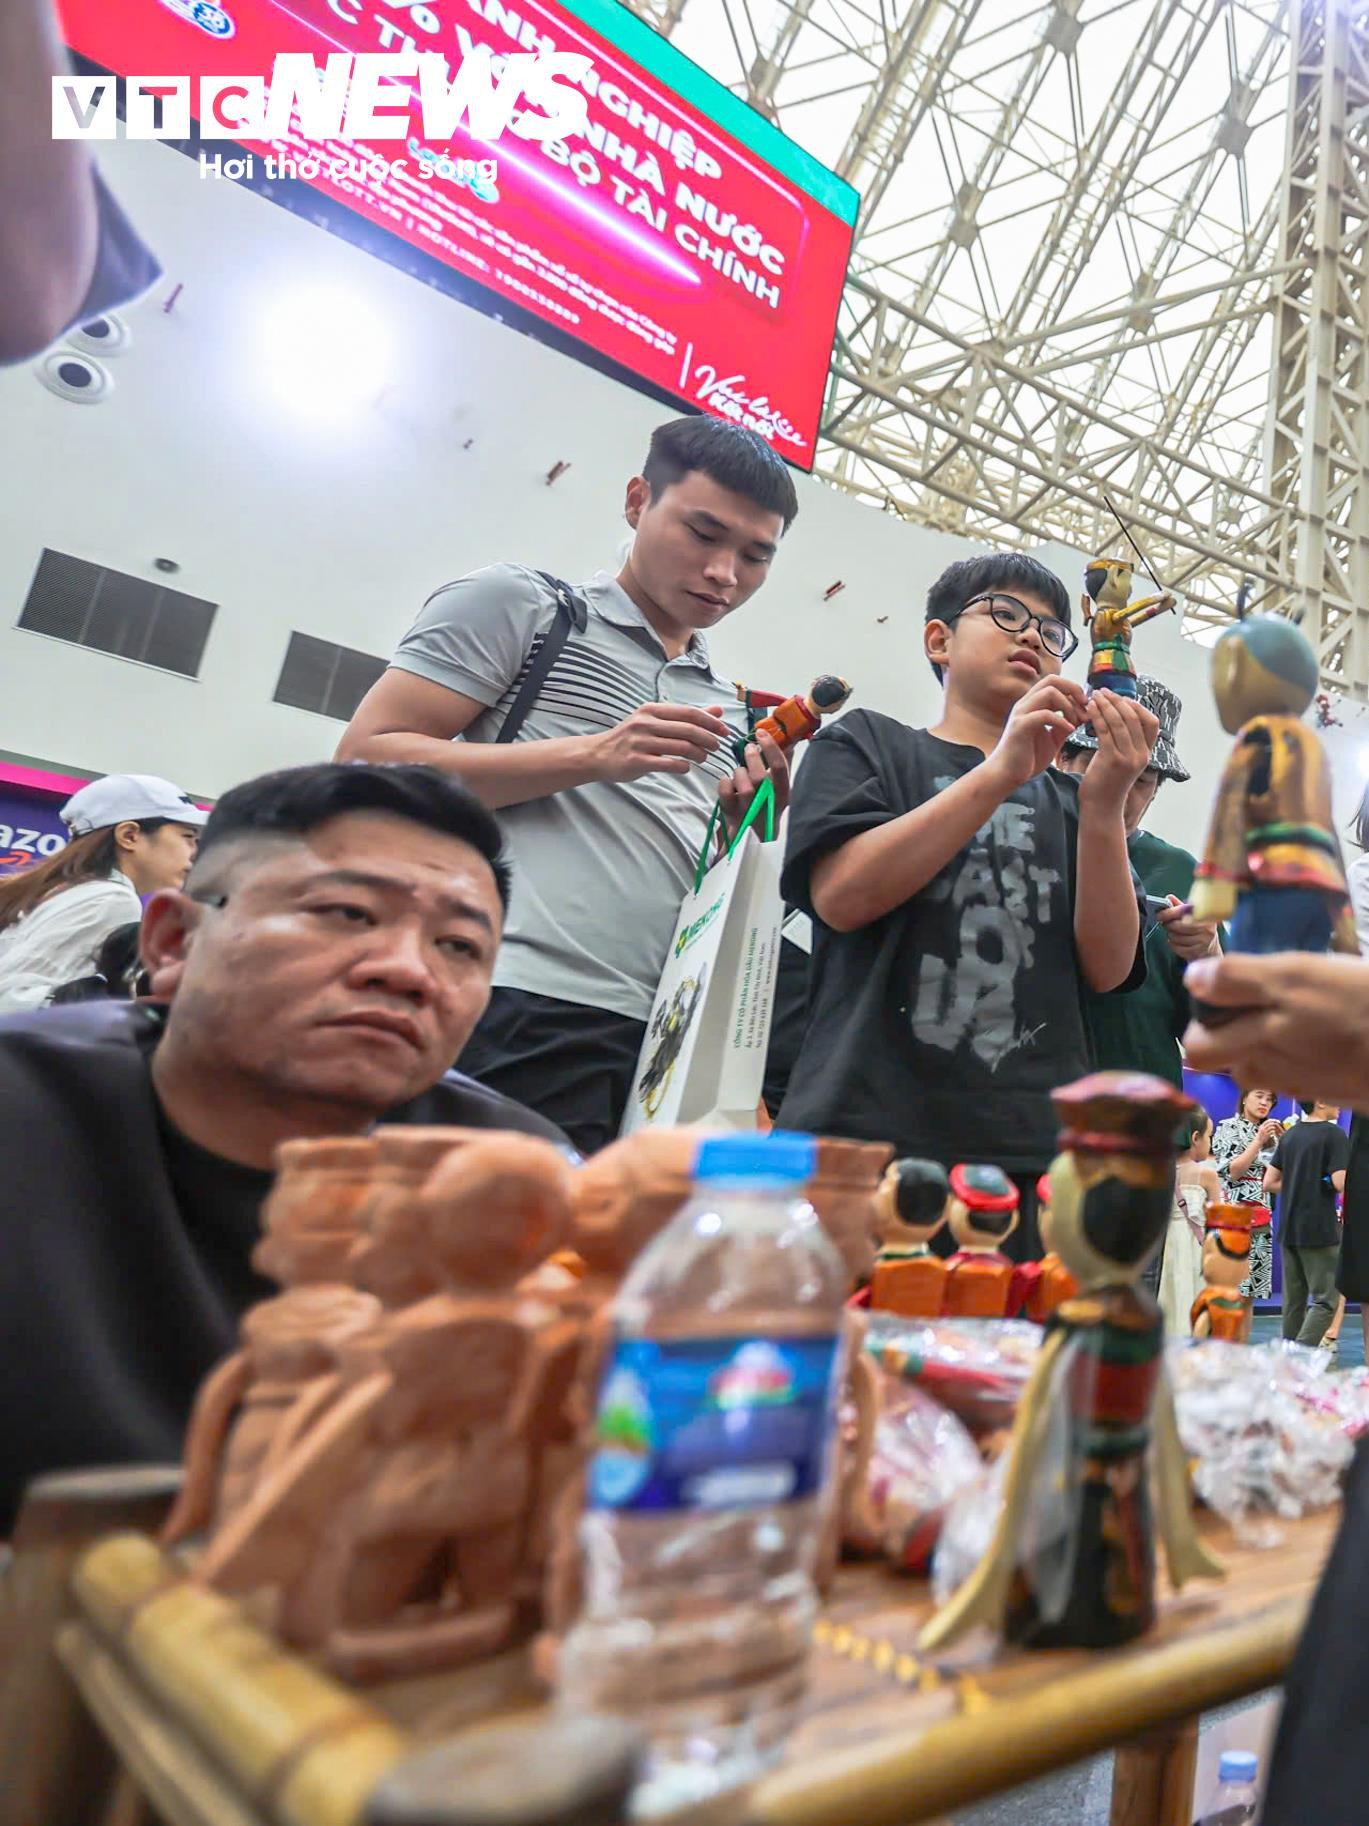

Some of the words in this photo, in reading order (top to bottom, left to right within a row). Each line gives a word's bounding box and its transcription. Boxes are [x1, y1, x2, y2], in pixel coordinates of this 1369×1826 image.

[540, 138, 602, 187] BỘ
[610, 174, 668, 233] TÀI
[674, 223, 780, 308] CHÍNH
[675, 181, 785, 276] NƯỚC
